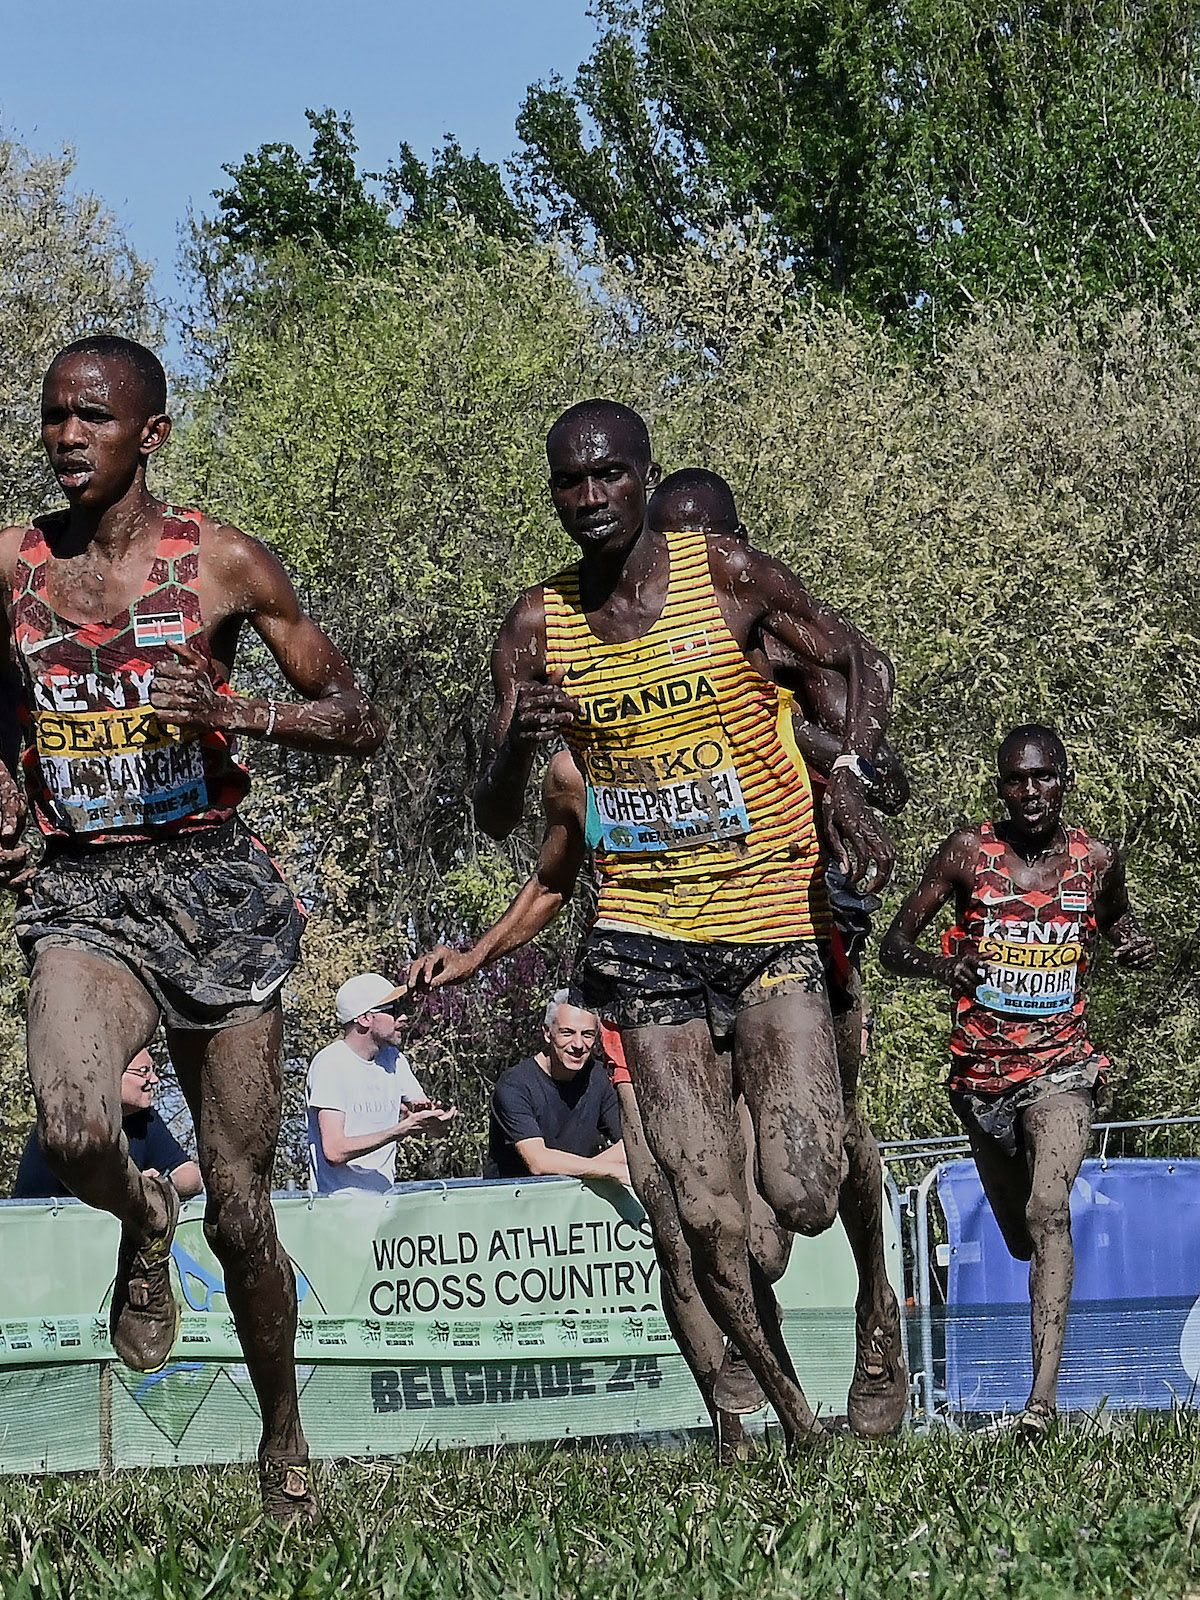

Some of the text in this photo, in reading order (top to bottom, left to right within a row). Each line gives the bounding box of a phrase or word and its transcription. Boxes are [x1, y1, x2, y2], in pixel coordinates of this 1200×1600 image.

[33, 668, 156, 711] KENY
[718, 814, 741, 829] 24
[984, 941, 1078, 969] SEIKO
[1003, 998, 1058, 1009] BELGRADE
[372, 1218, 655, 1271] WORLD ATHLETICS
[369, 1259, 657, 1316] CROSS COUNTRY
[371, 1356, 663, 1414] BELGRADE 24
